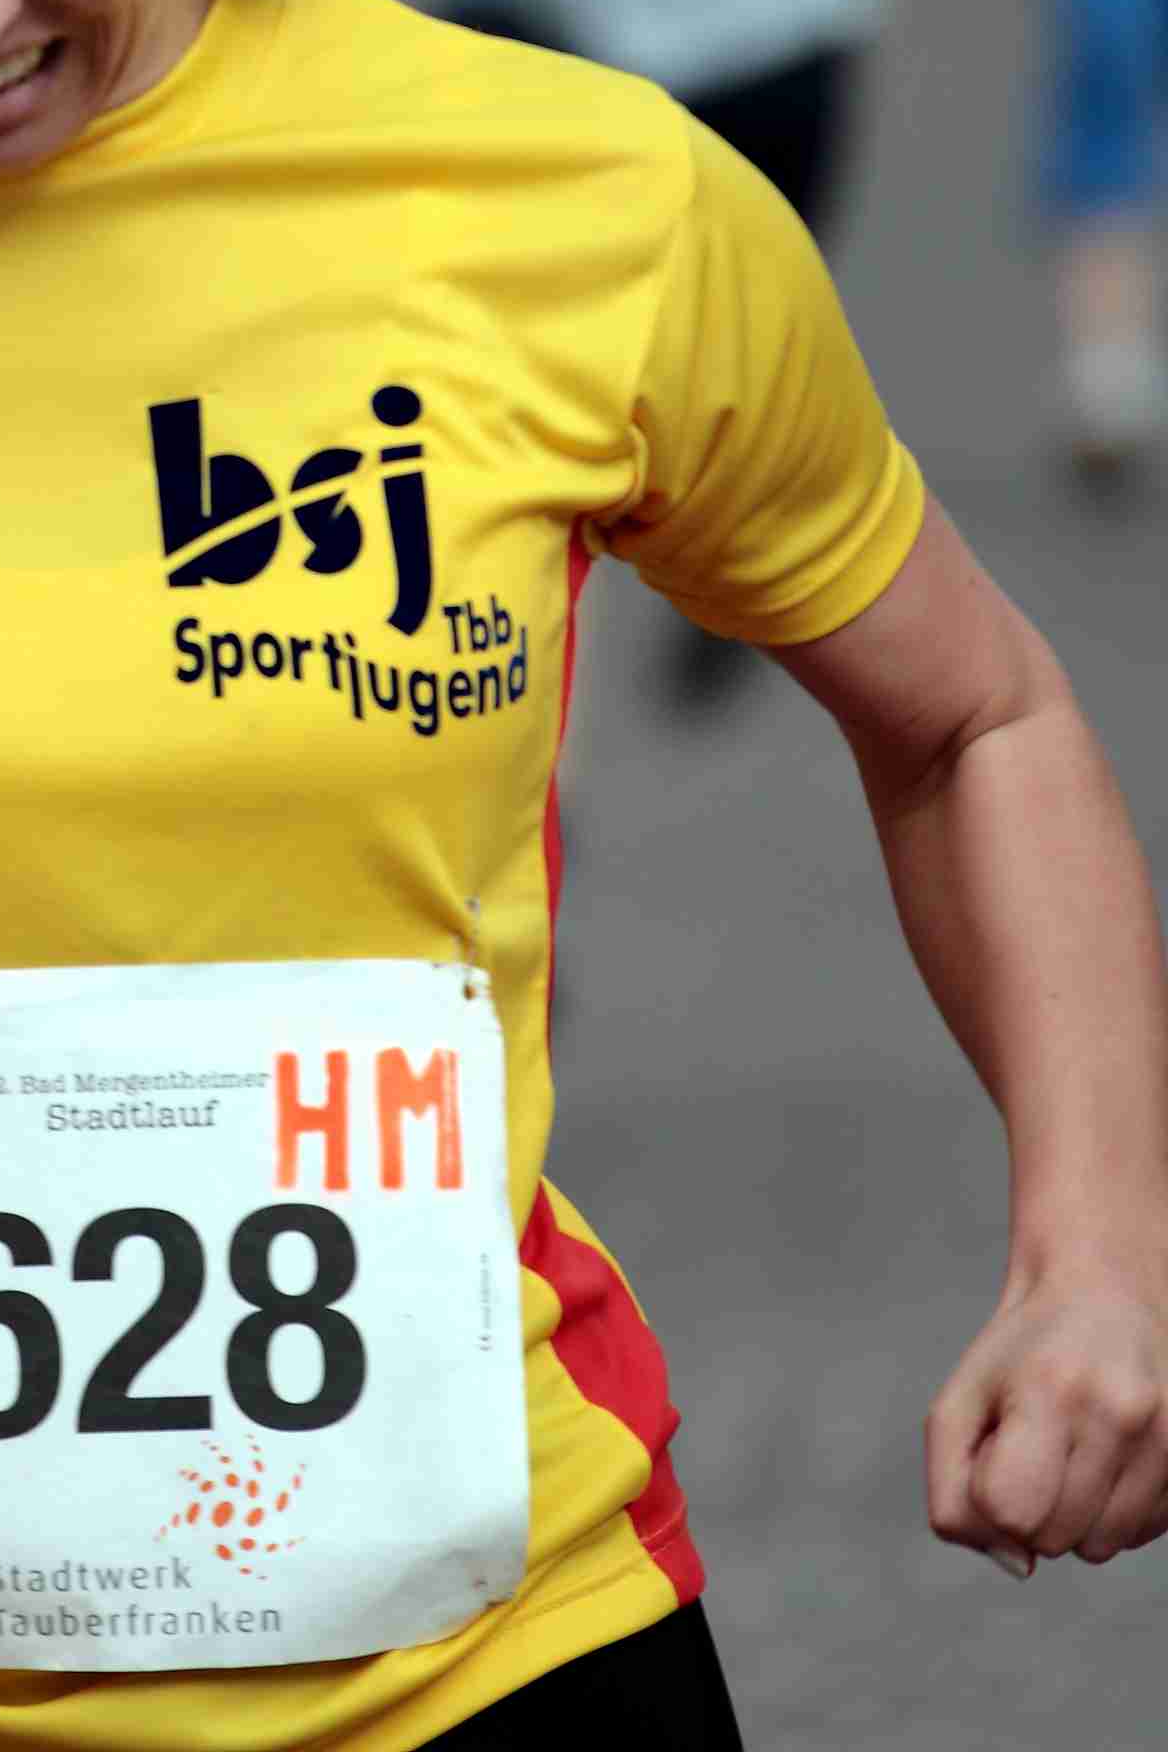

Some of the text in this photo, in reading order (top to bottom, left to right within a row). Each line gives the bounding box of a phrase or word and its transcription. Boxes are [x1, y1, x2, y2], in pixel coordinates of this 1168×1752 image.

[148, 385, 434, 637] bsj
[441, 594, 512, 655] Tbb
[173, 616, 529, 737] Sportjugend
[19, 1073, 68, 1096] Bad
[73, 1070, 271, 1097] Mergentheimer
[45, 1098, 221, 1133] Stadtlauf
[273, 1047, 465, 1192] HM
